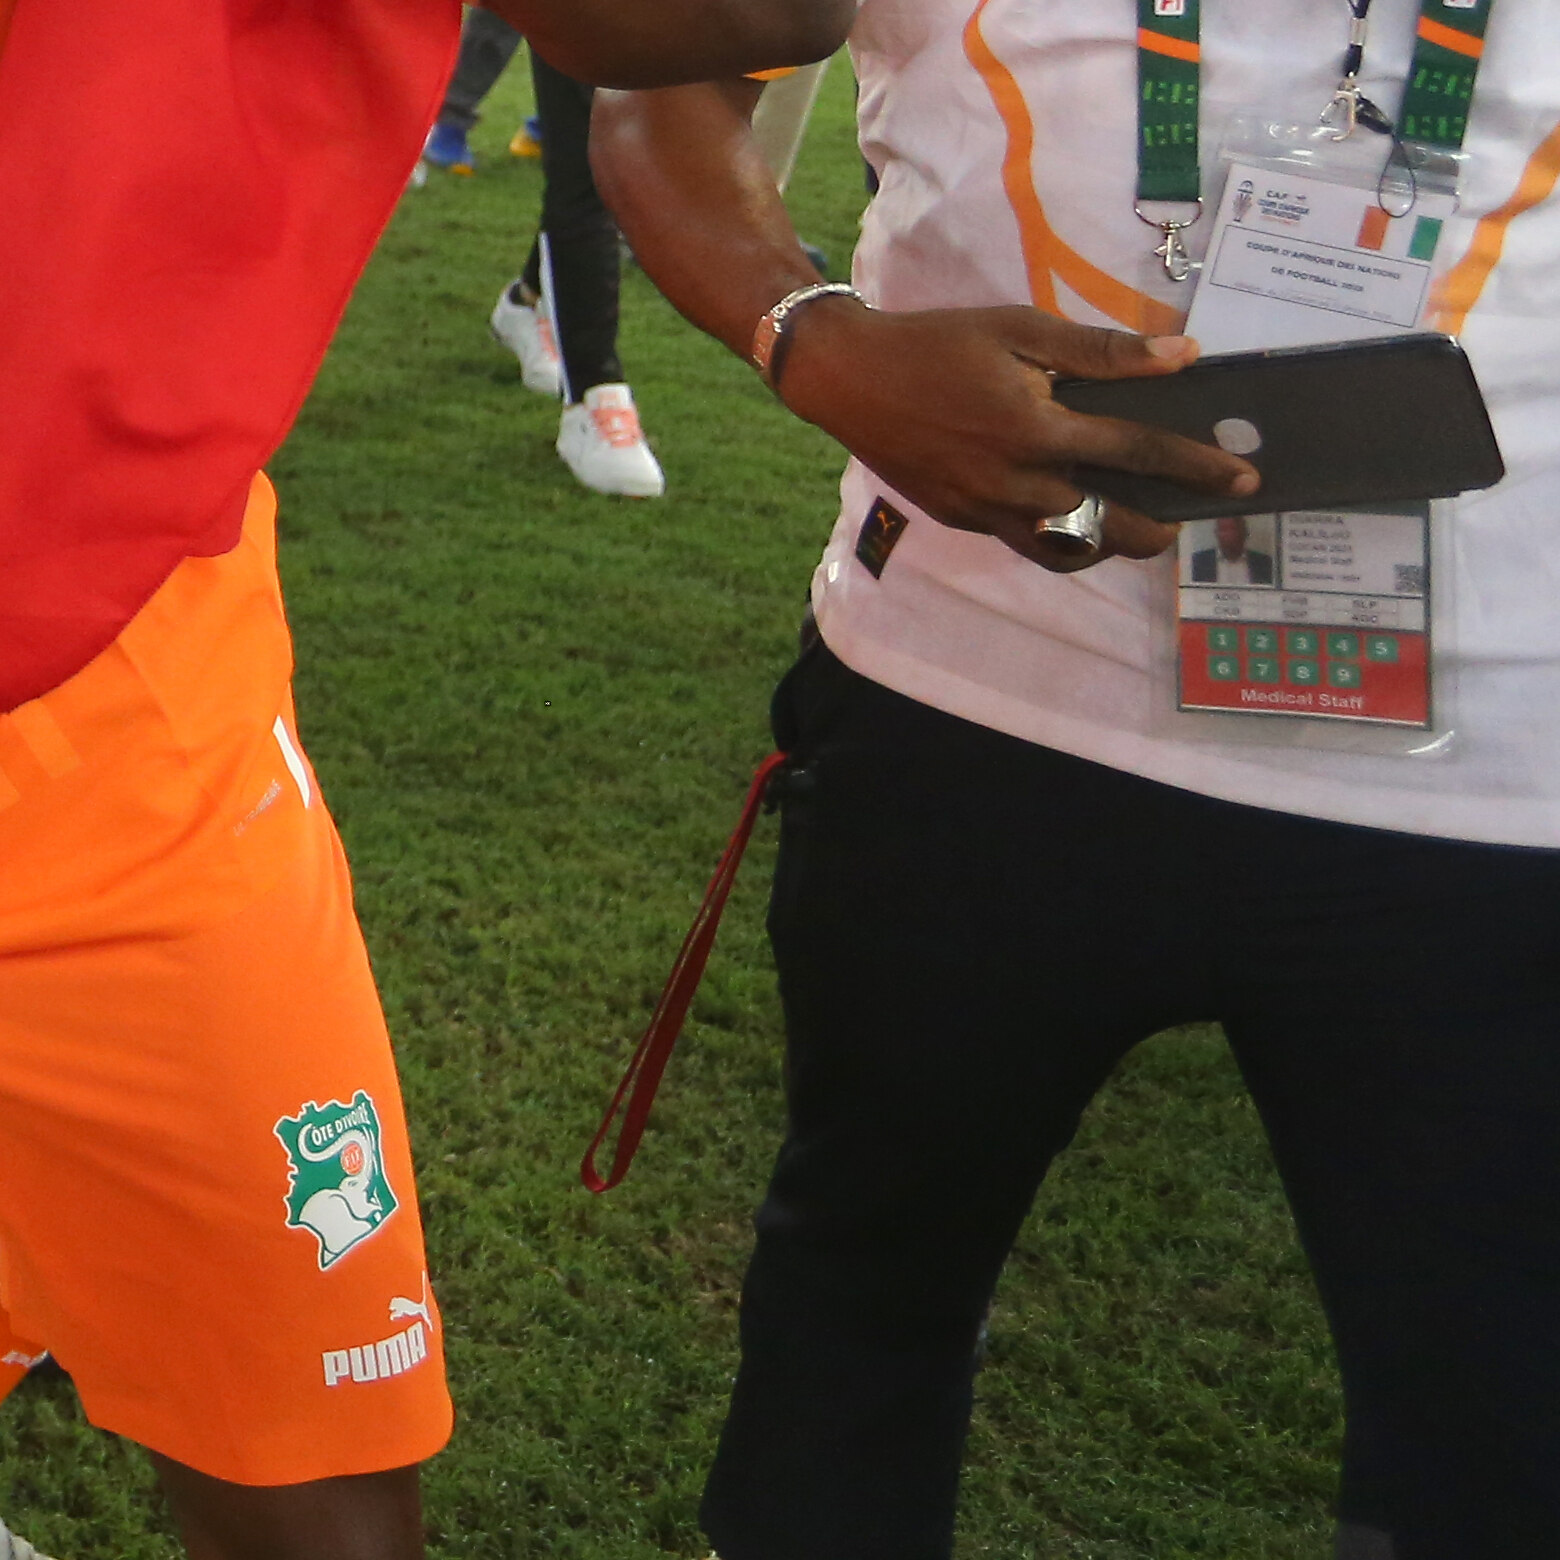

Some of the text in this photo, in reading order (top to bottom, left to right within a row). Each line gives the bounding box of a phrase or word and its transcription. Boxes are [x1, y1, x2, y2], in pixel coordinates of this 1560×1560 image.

[1217, 634, 1388, 655] 1 2 3 4 5
[1217, 662, 1351, 682] 6 7 8 9
[1241, 689, 1364, 709] Medical Staff
[321, 1321, 428, 1387] PUMA
